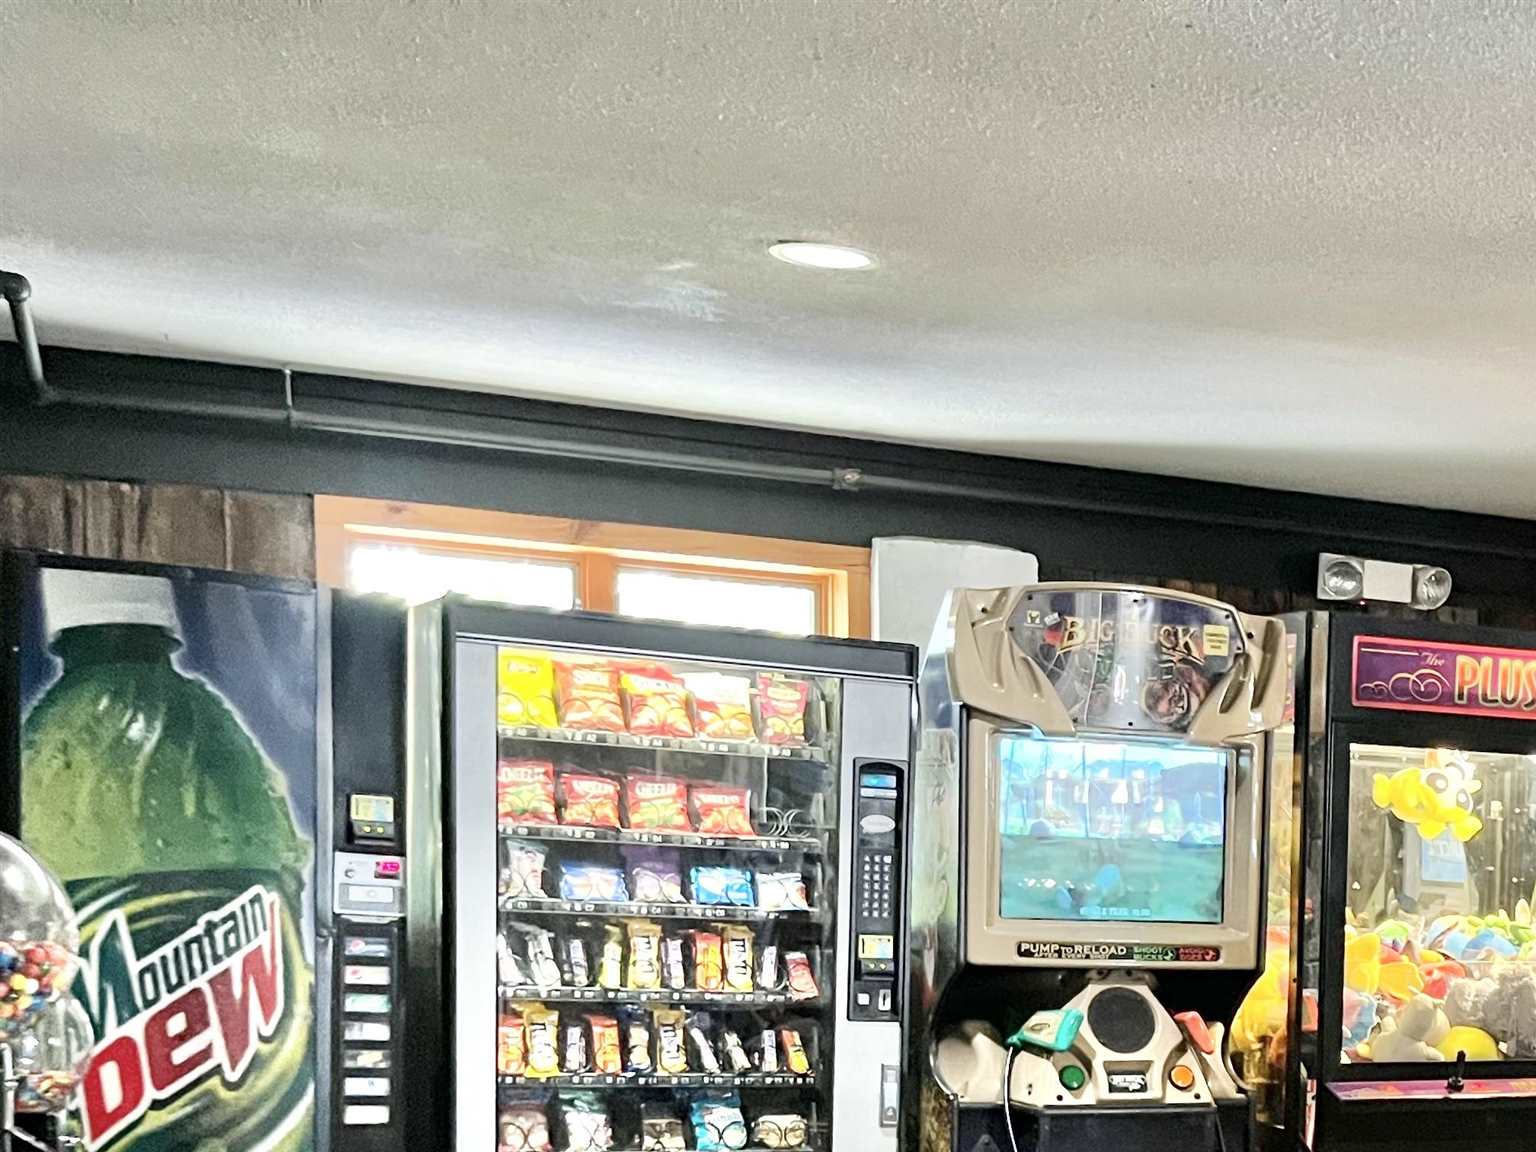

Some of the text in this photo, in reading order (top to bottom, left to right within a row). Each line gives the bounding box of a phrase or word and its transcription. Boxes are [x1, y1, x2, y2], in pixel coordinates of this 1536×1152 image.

[1419, 651, 1446, 667] The
[1021, 943, 1059, 953] PUMP
[1076, 945, 1127, 956] RELOAD
[71, 890, 270, 1043] Mountain
